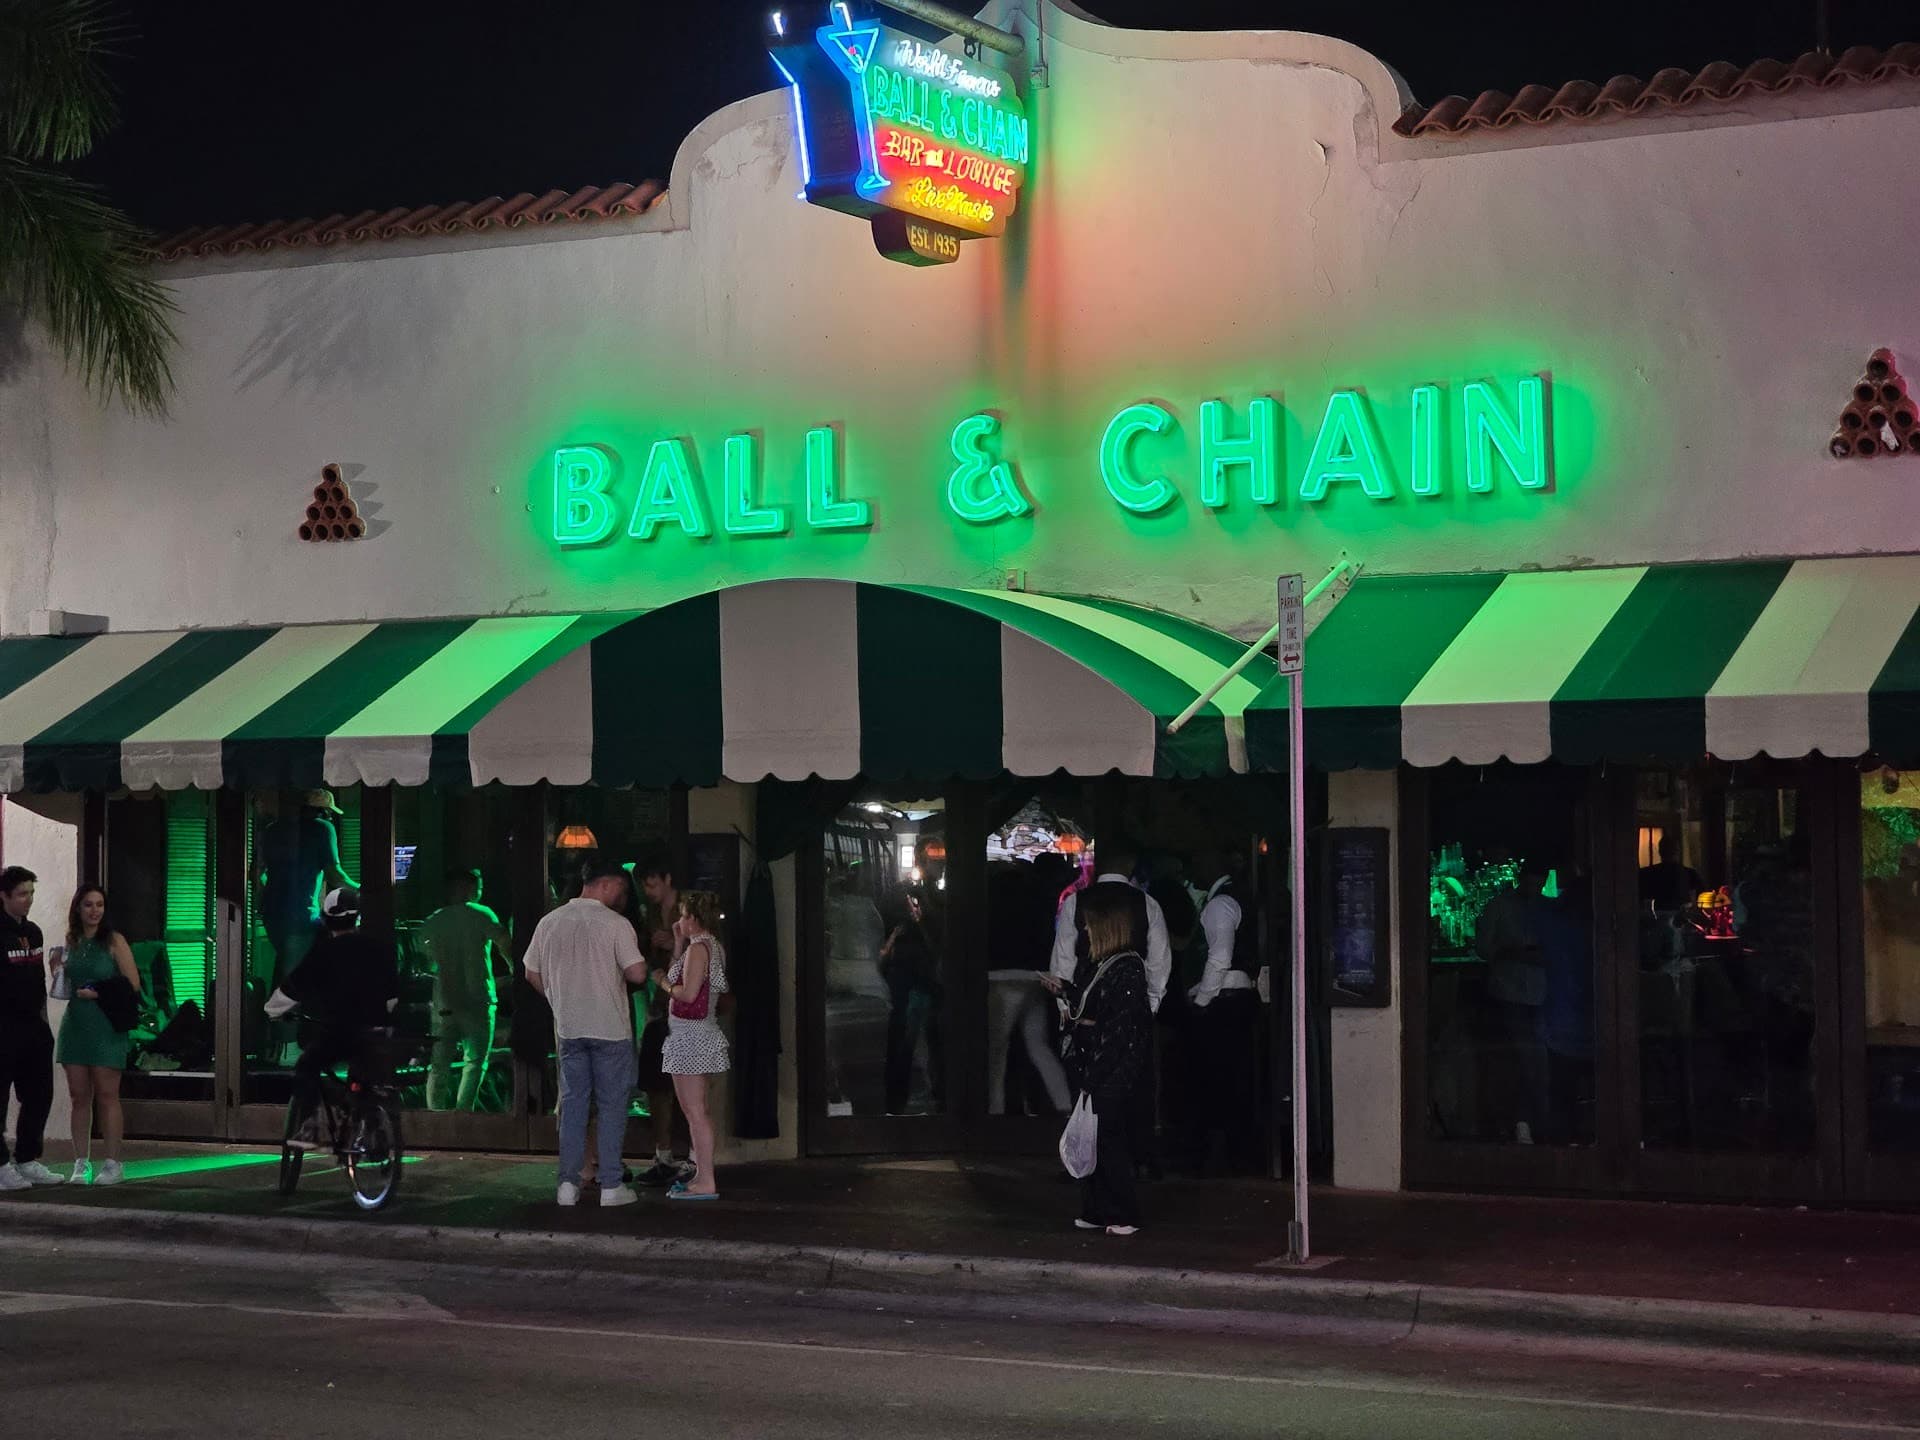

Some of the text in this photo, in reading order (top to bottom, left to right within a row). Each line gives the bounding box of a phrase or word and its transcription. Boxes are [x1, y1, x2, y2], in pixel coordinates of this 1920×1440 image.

[869, 66, 1028, 164] BALL & CHAIN
[881, 131, 924, 167] BAR
[943, 151, 1015, 195] LOUNGE
[933, 231, 957, 257] 1935
[553, 375, 1546, 545] BALL & CHAIN
